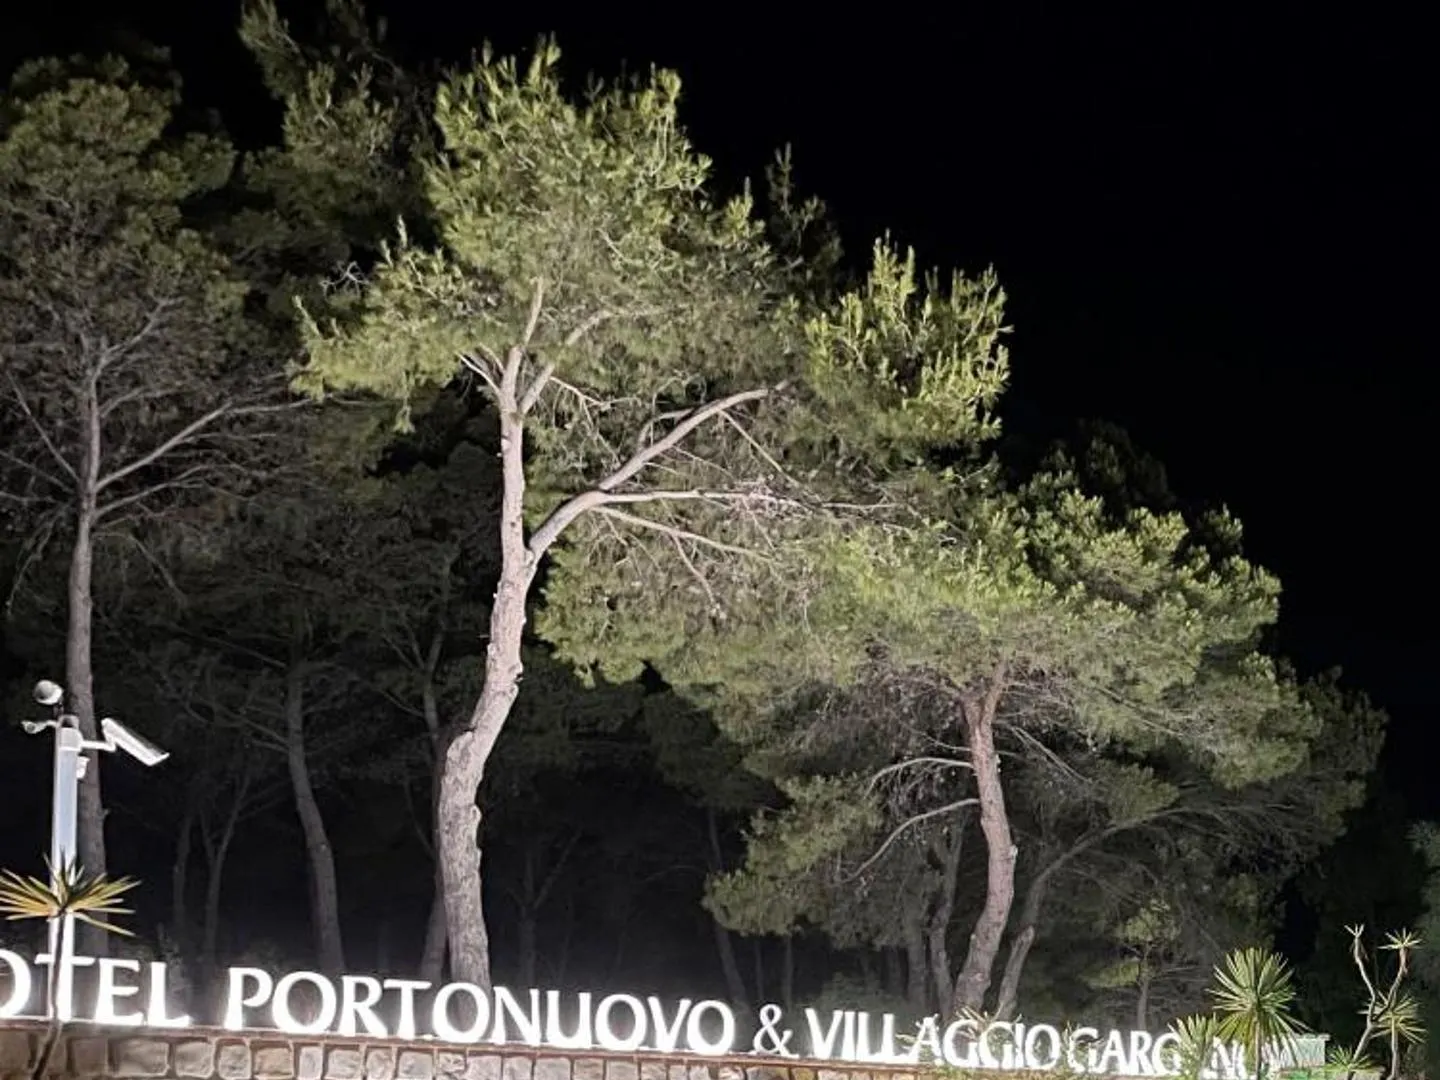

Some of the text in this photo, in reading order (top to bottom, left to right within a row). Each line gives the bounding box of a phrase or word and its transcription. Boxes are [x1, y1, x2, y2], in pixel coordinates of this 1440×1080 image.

[224, 966, 736, 1052] PORTONUOVO
[753, 1003, 798, 1057] &
[804, 1008, 1060, 1069] VILLAGGIO
